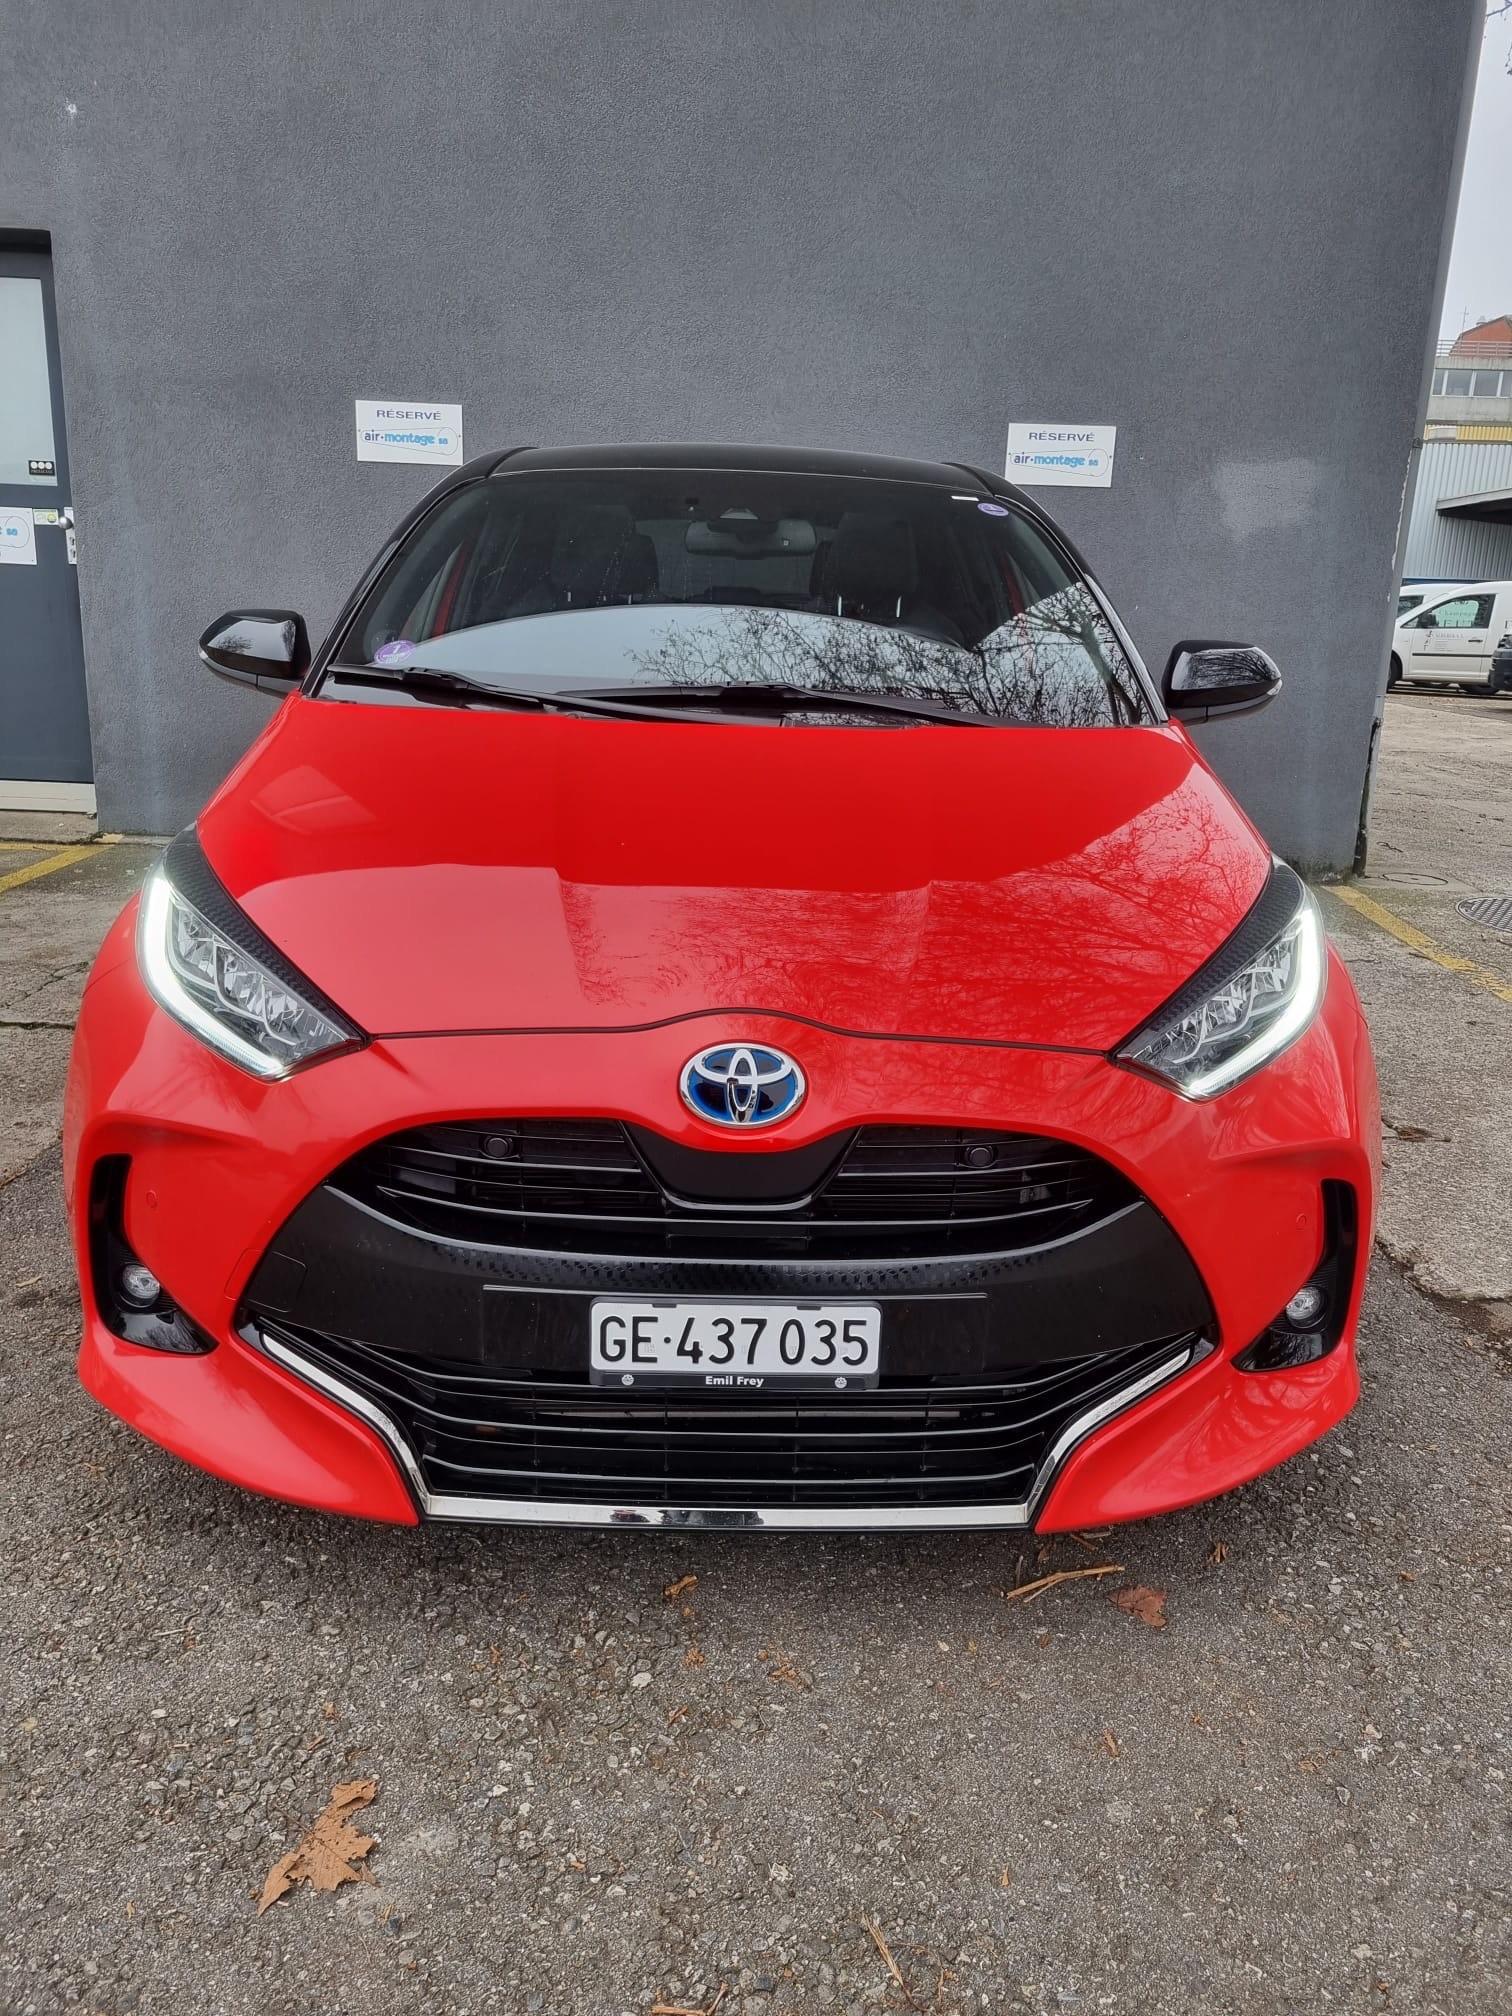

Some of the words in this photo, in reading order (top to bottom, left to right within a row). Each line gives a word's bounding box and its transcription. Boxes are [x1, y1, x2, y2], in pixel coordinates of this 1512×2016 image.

[376, 408, 442, 421] RÉSERVÉ
[1028, 431, 1095, 442] RÉSERVÉ
[705, 1375, 733, 1386] Emil
[737, 1376, 765, 1388] Frey
